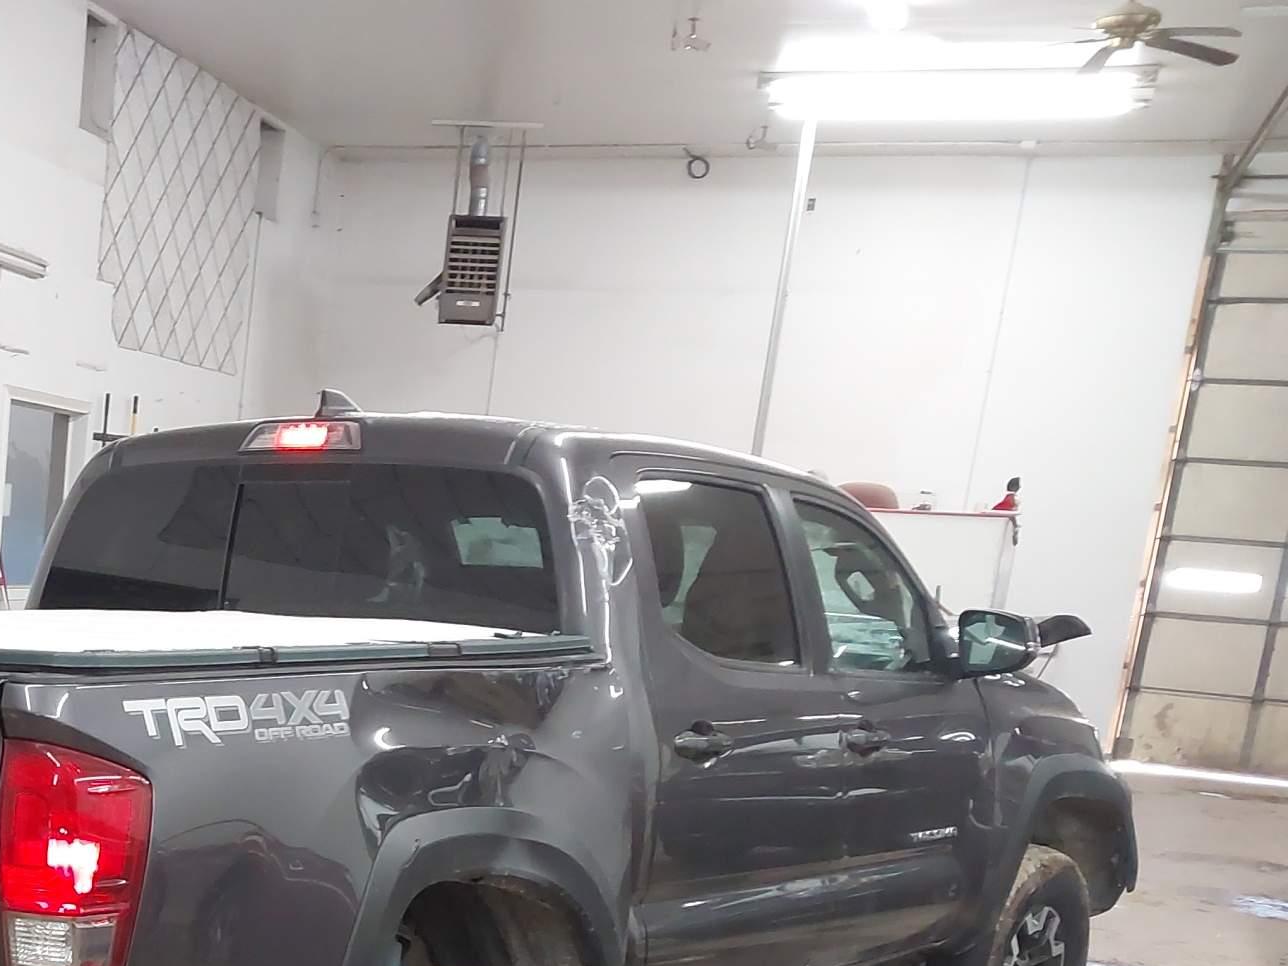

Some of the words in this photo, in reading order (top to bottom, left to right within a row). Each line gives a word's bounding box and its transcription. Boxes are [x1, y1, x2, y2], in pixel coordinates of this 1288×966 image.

[123, 695, 253, 748] TRD
[254, 726, 295, 743] OFF
[295, 722, 351, 741] ROAD
